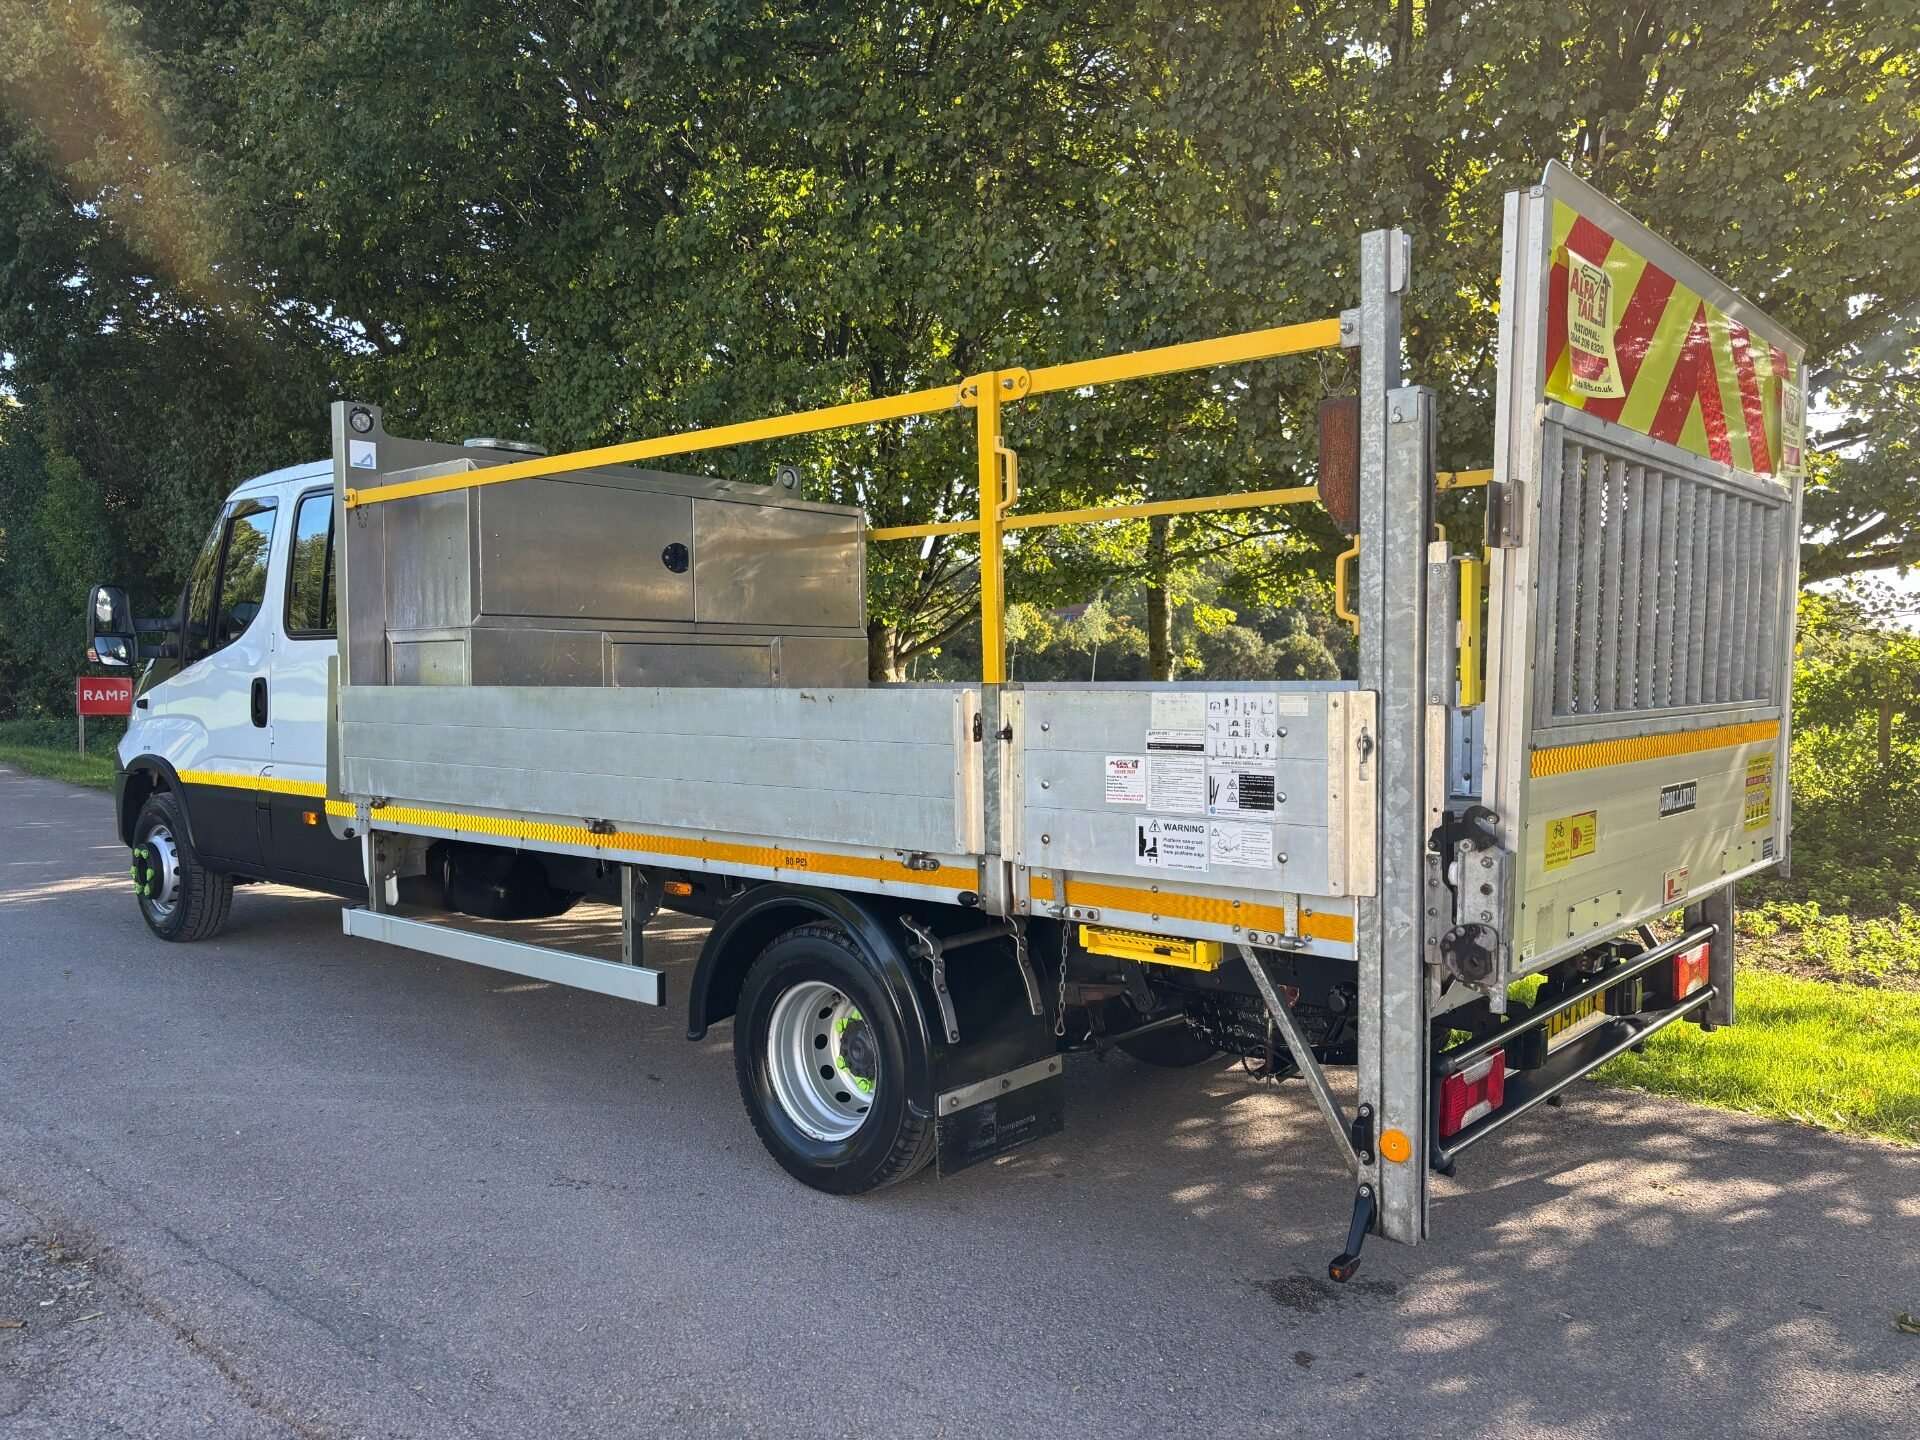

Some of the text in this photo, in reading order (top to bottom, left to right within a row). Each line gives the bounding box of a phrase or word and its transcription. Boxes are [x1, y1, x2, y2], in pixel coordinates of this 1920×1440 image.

[1570, 267, 1594, 303] ALFA
[1578, 296, 1594, 321] TAIL
[83, 689, 129, 701] RAMP
[1163, 823, 1205, 834] WARNING
